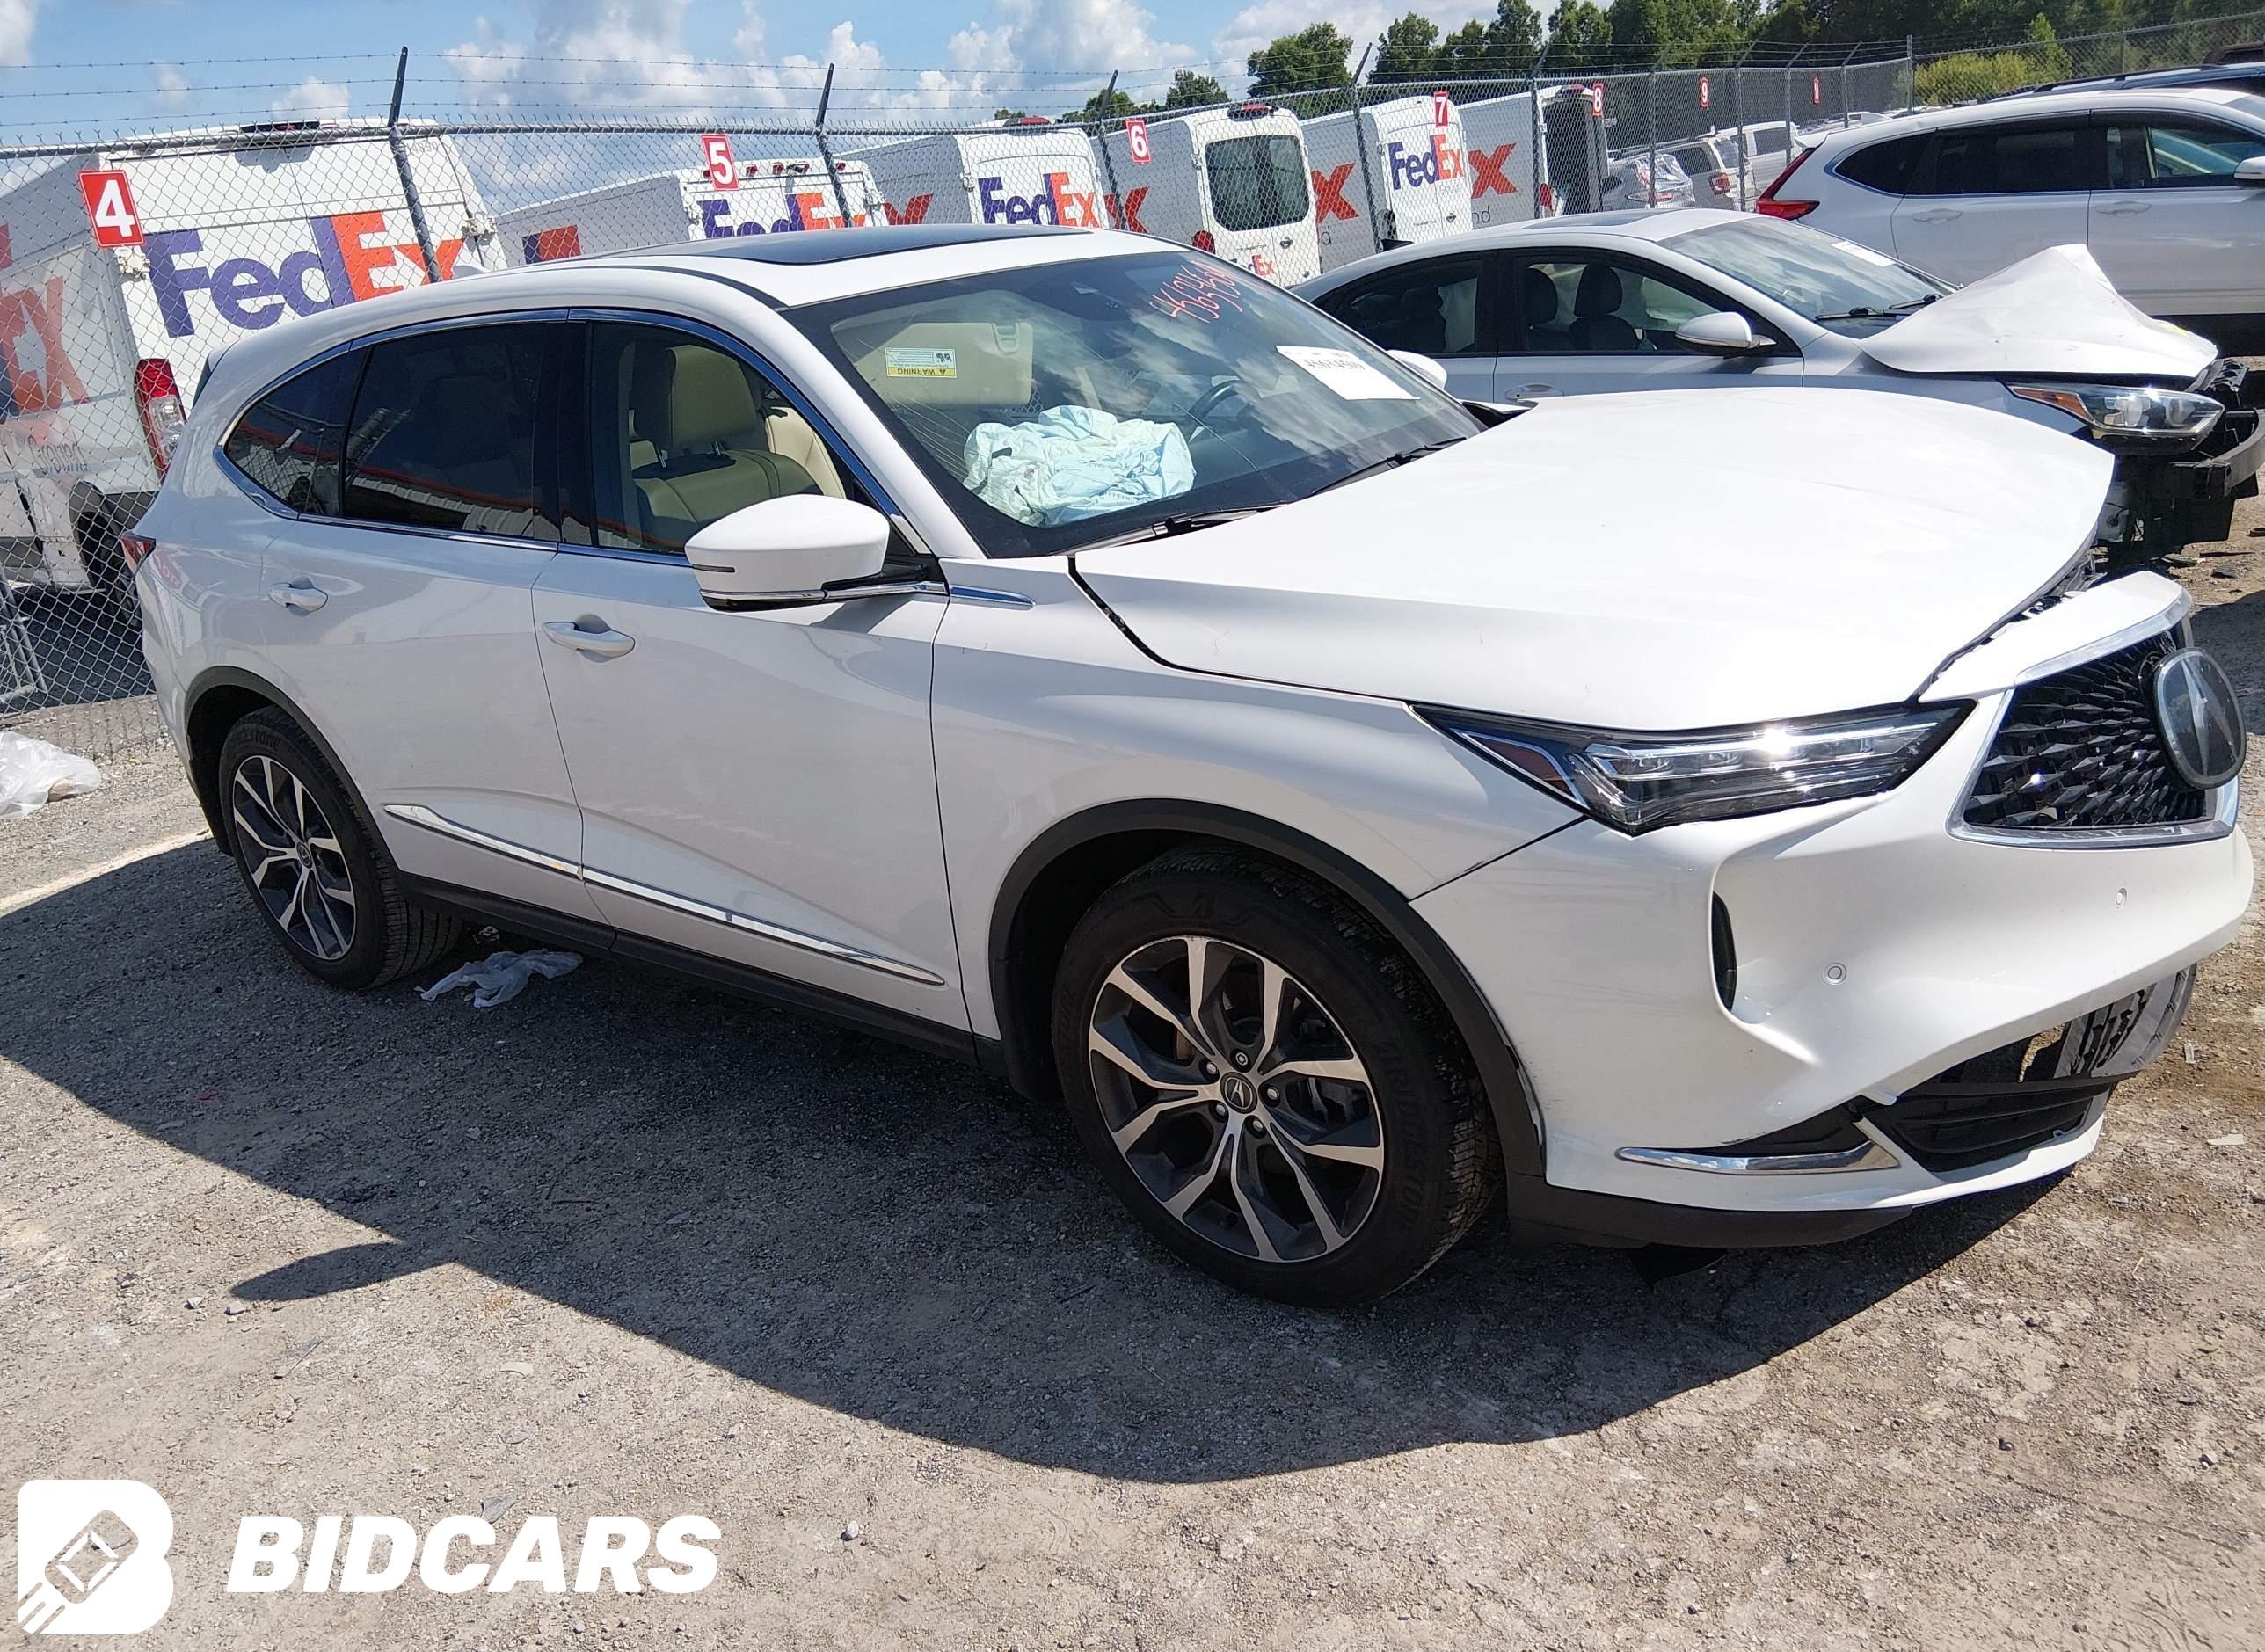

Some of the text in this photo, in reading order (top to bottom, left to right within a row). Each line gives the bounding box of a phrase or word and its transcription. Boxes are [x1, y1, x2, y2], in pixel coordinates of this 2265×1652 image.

[1594, 87, 1603, 113] 8
[1701, 82, 1708, 104] 9
[1435, 96, 1447, 124] 7
[1132, 125, 1147, 158] 6
[709, 142, 733, 186] 5
[1387, 134, 1465, 191] FedEx
[94, 179, 135, 237] 4
